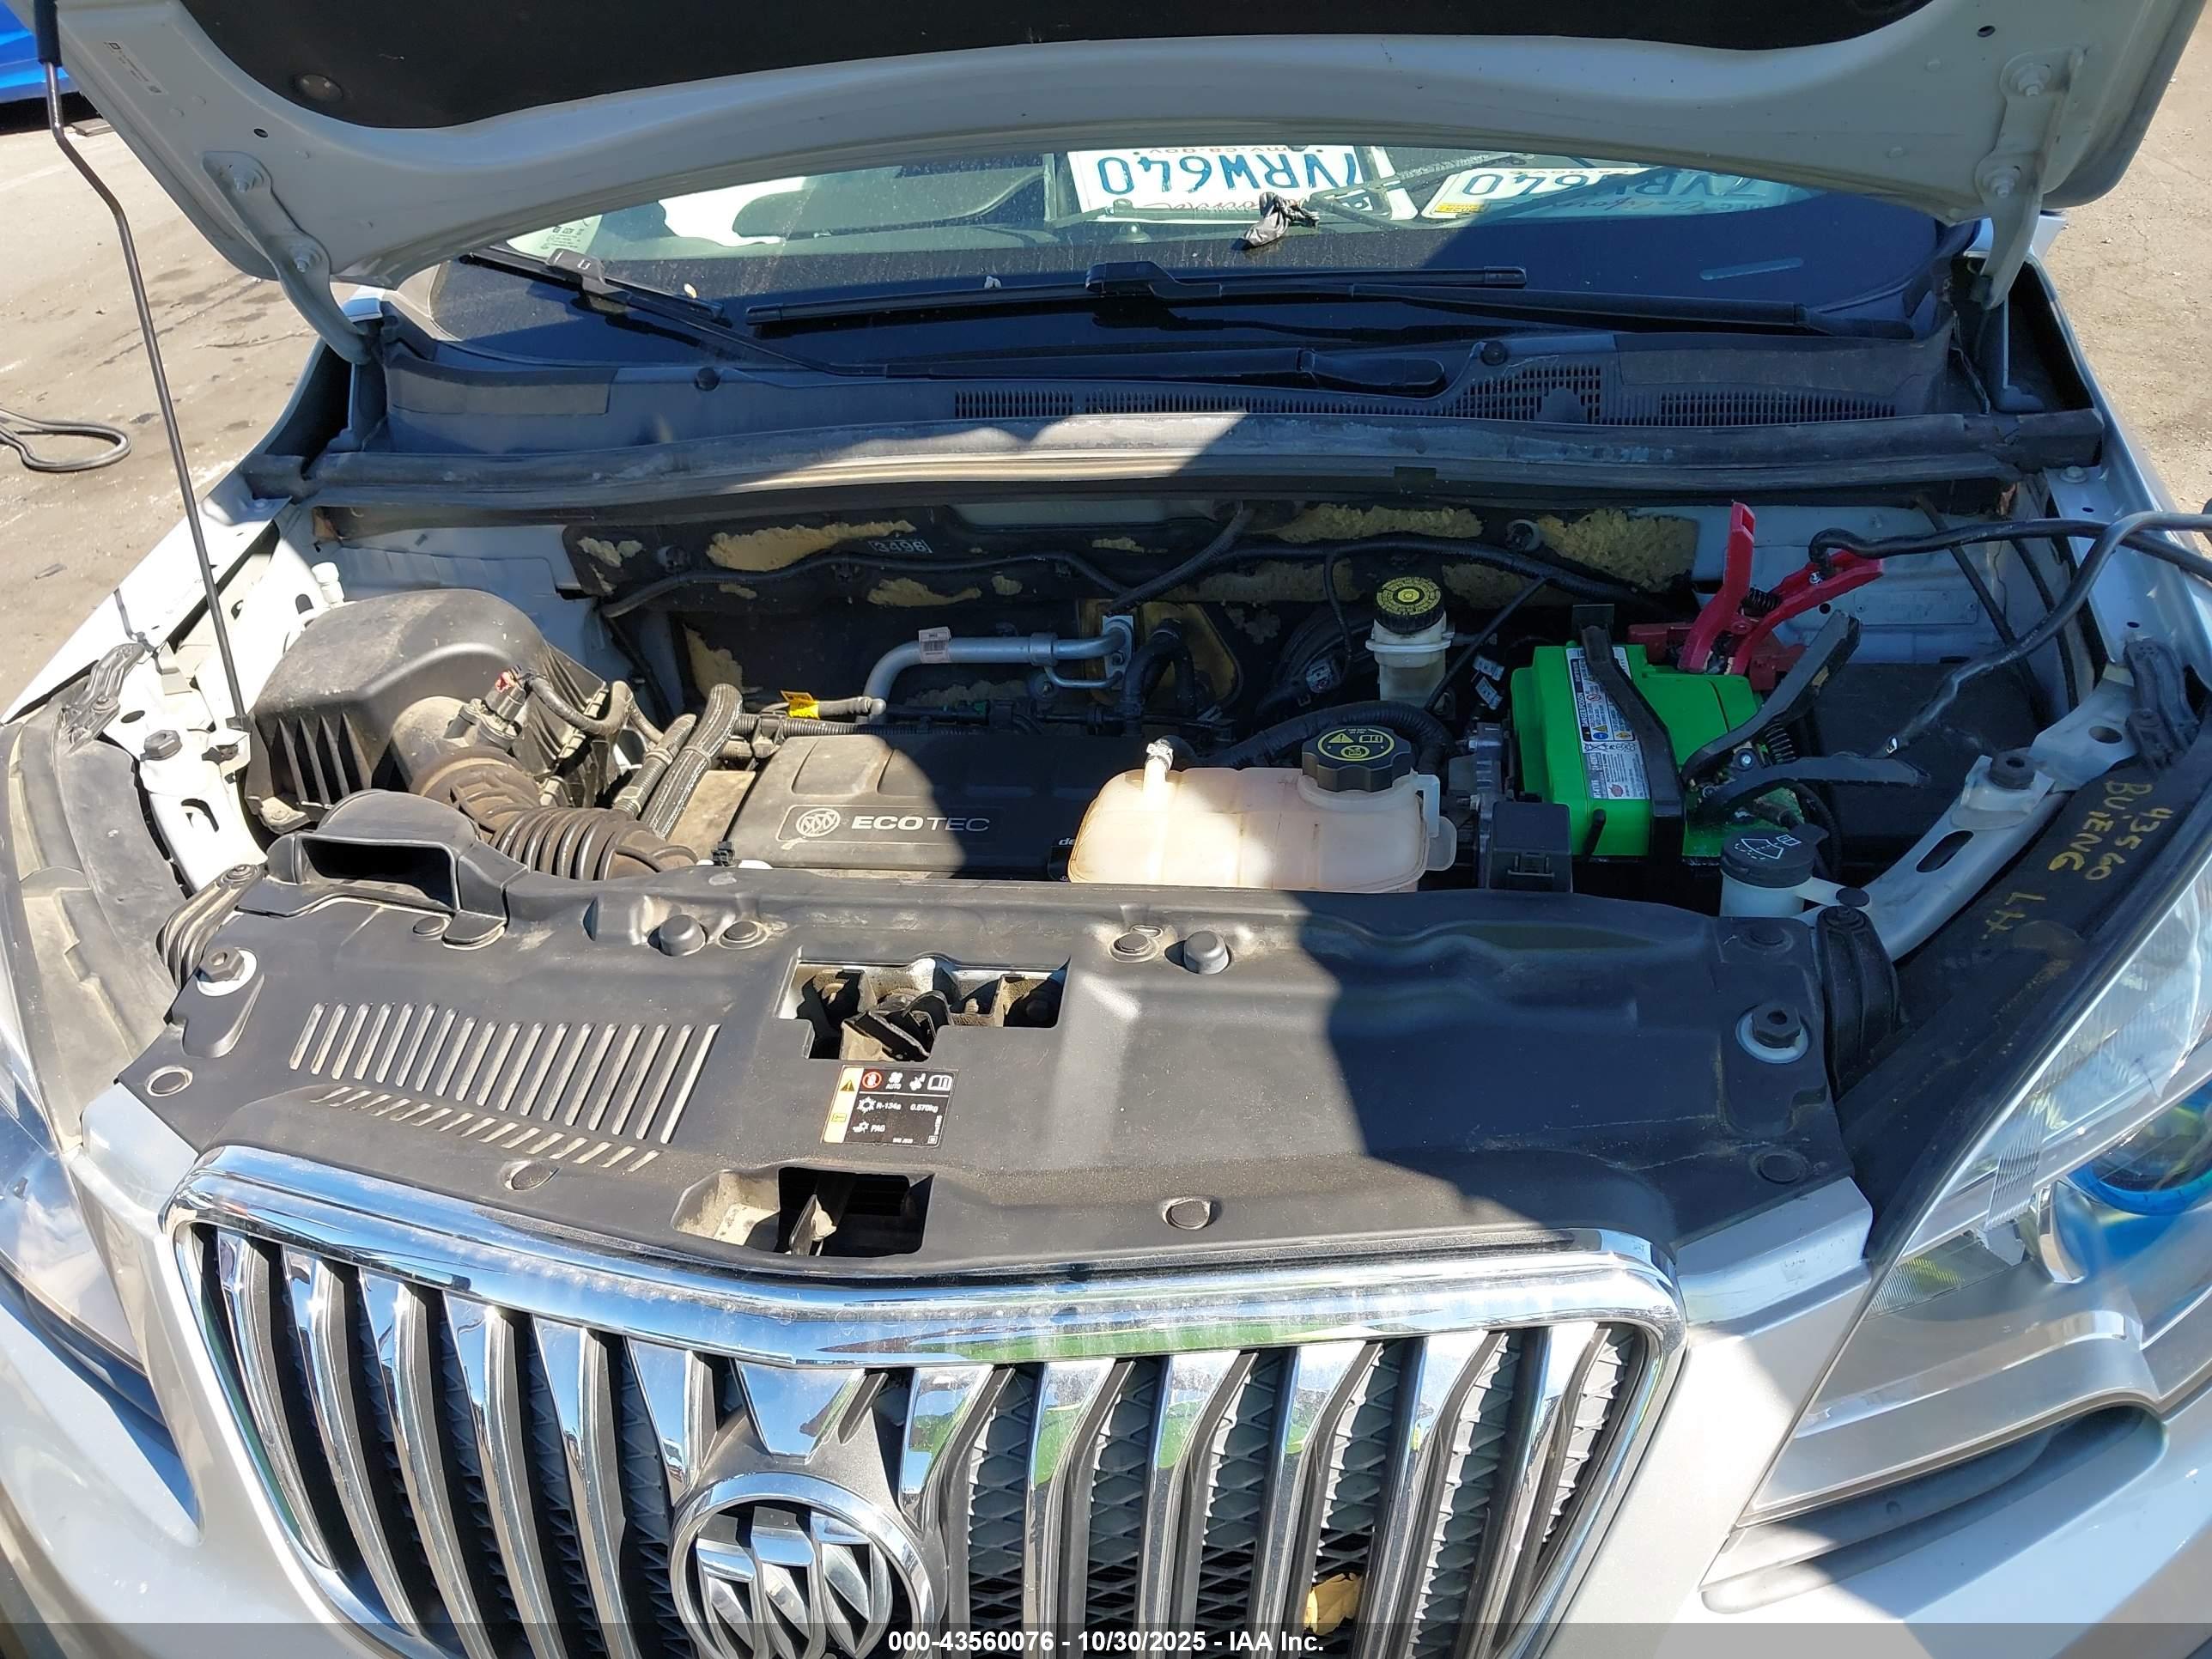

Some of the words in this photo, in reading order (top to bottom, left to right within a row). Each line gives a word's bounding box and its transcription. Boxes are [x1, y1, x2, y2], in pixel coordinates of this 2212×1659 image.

[1148, 146, 1289, 155] mv.ca.gov
[1462, 170, 1767, 198] 7VR640
[874, 540, 927, 553] 3496
[851, 816, 990, 832] ECOTEC
[2085, 807, 2174, 880] 43560
[876, 1103, 902, 1111] R-134a
